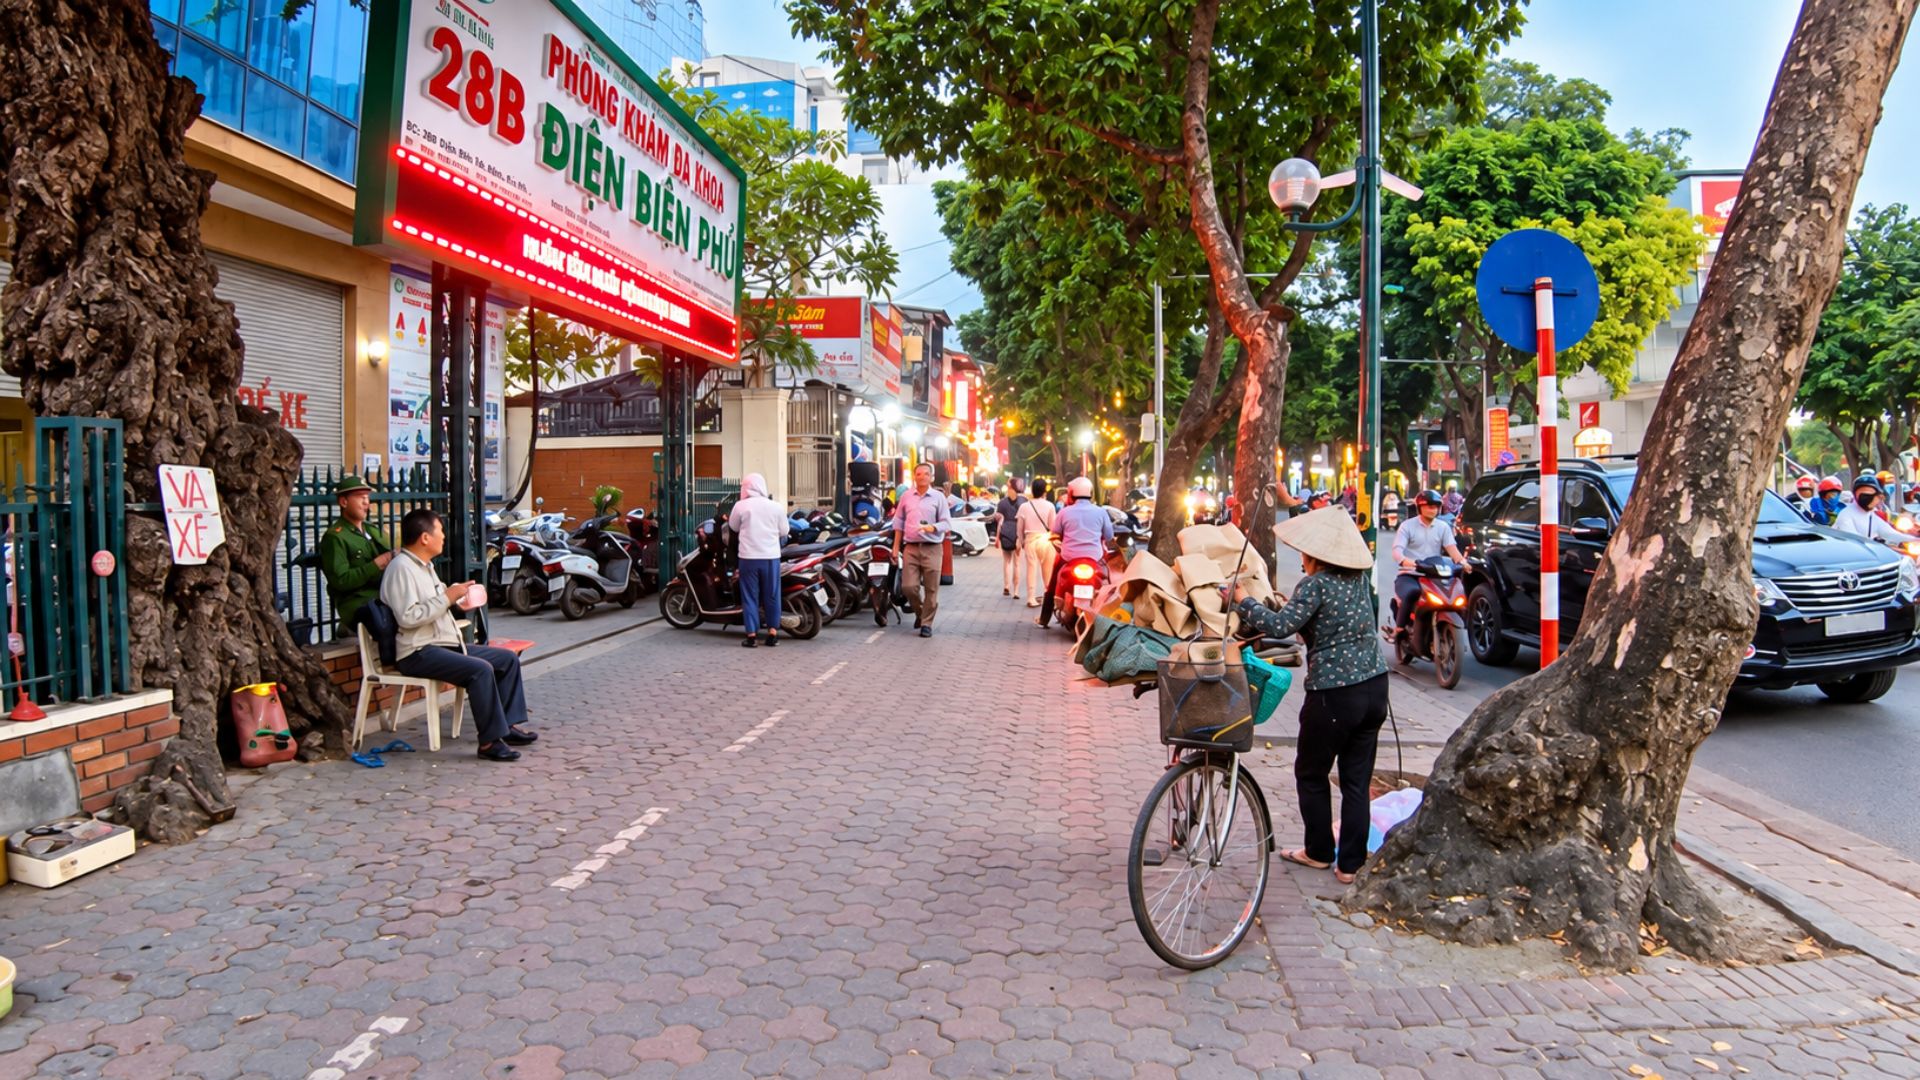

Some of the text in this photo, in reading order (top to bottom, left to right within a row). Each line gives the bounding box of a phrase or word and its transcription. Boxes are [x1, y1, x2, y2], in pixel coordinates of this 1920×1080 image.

[429, 27, 525, 145] 28B
[548, 34, 619, 126] PHÒNG
[673, 143, 691, 186] ĐA
[694, 161, 724, 214] KHOA
[541, 102, 625, 211] ĐIỆN
[698, 215, 736, 280] PHỦ
[279, 391, 308, 429] XE
